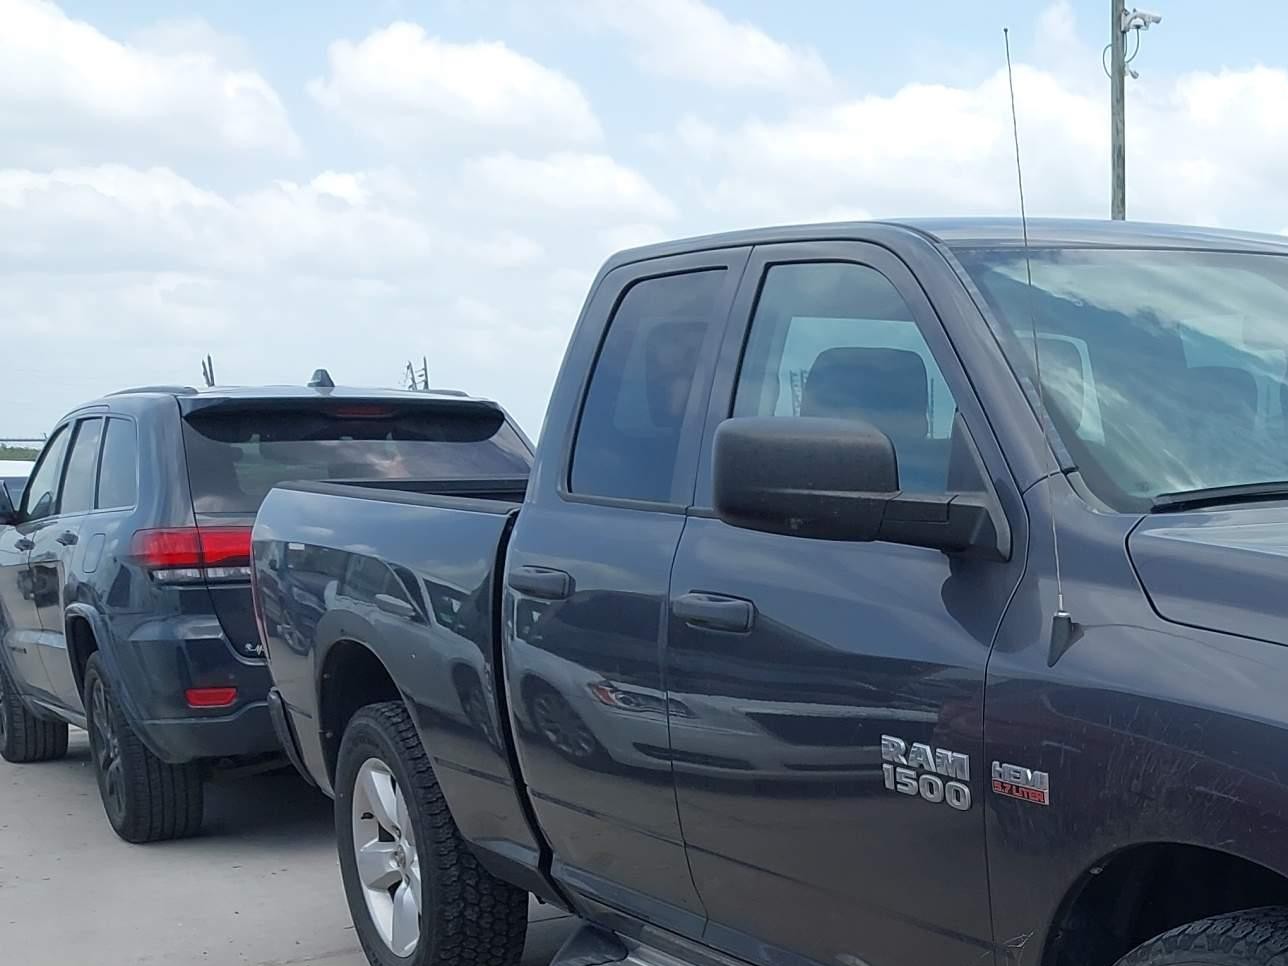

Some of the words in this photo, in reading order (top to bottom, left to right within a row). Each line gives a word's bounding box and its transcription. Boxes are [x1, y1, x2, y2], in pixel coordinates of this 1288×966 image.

[881, 734, 970, 781] RAM
[991, 760, 1049, 791] HEMI
[882, 763, 972, 810] 1500
[993, 779, 1010, 794] 5.7
[1012, 783, 1045, 803] LITER
